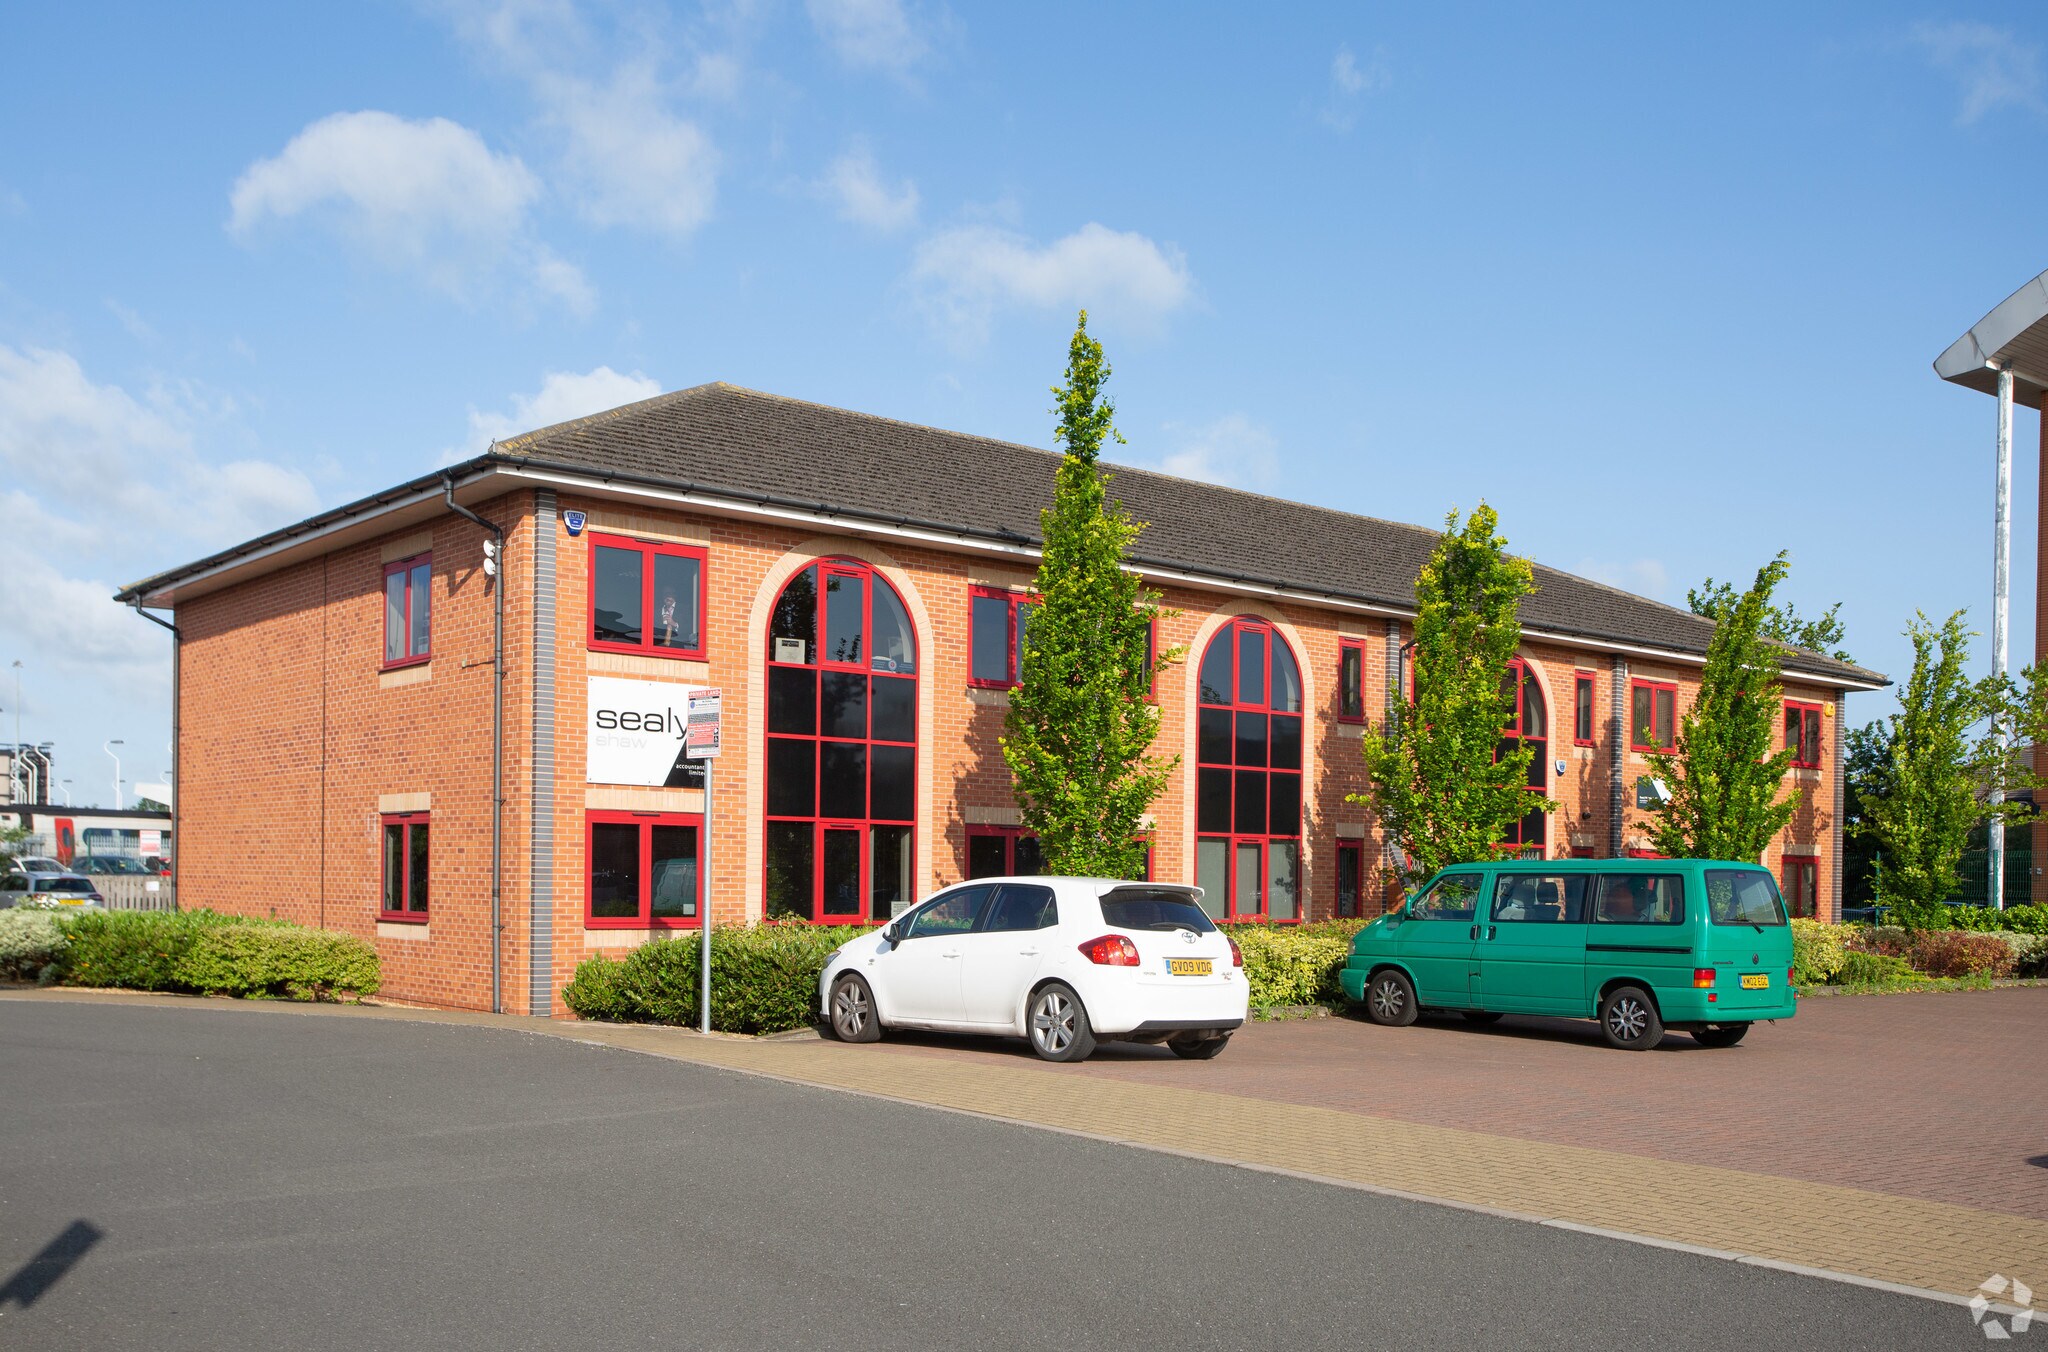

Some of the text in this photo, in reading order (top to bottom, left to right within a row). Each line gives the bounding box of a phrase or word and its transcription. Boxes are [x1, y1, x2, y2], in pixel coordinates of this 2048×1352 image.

[596, 707, 687, 740] sealy
[596, 732, 647, 748] shaw
[1171, 961, 1212, 972] GV09 VDG
